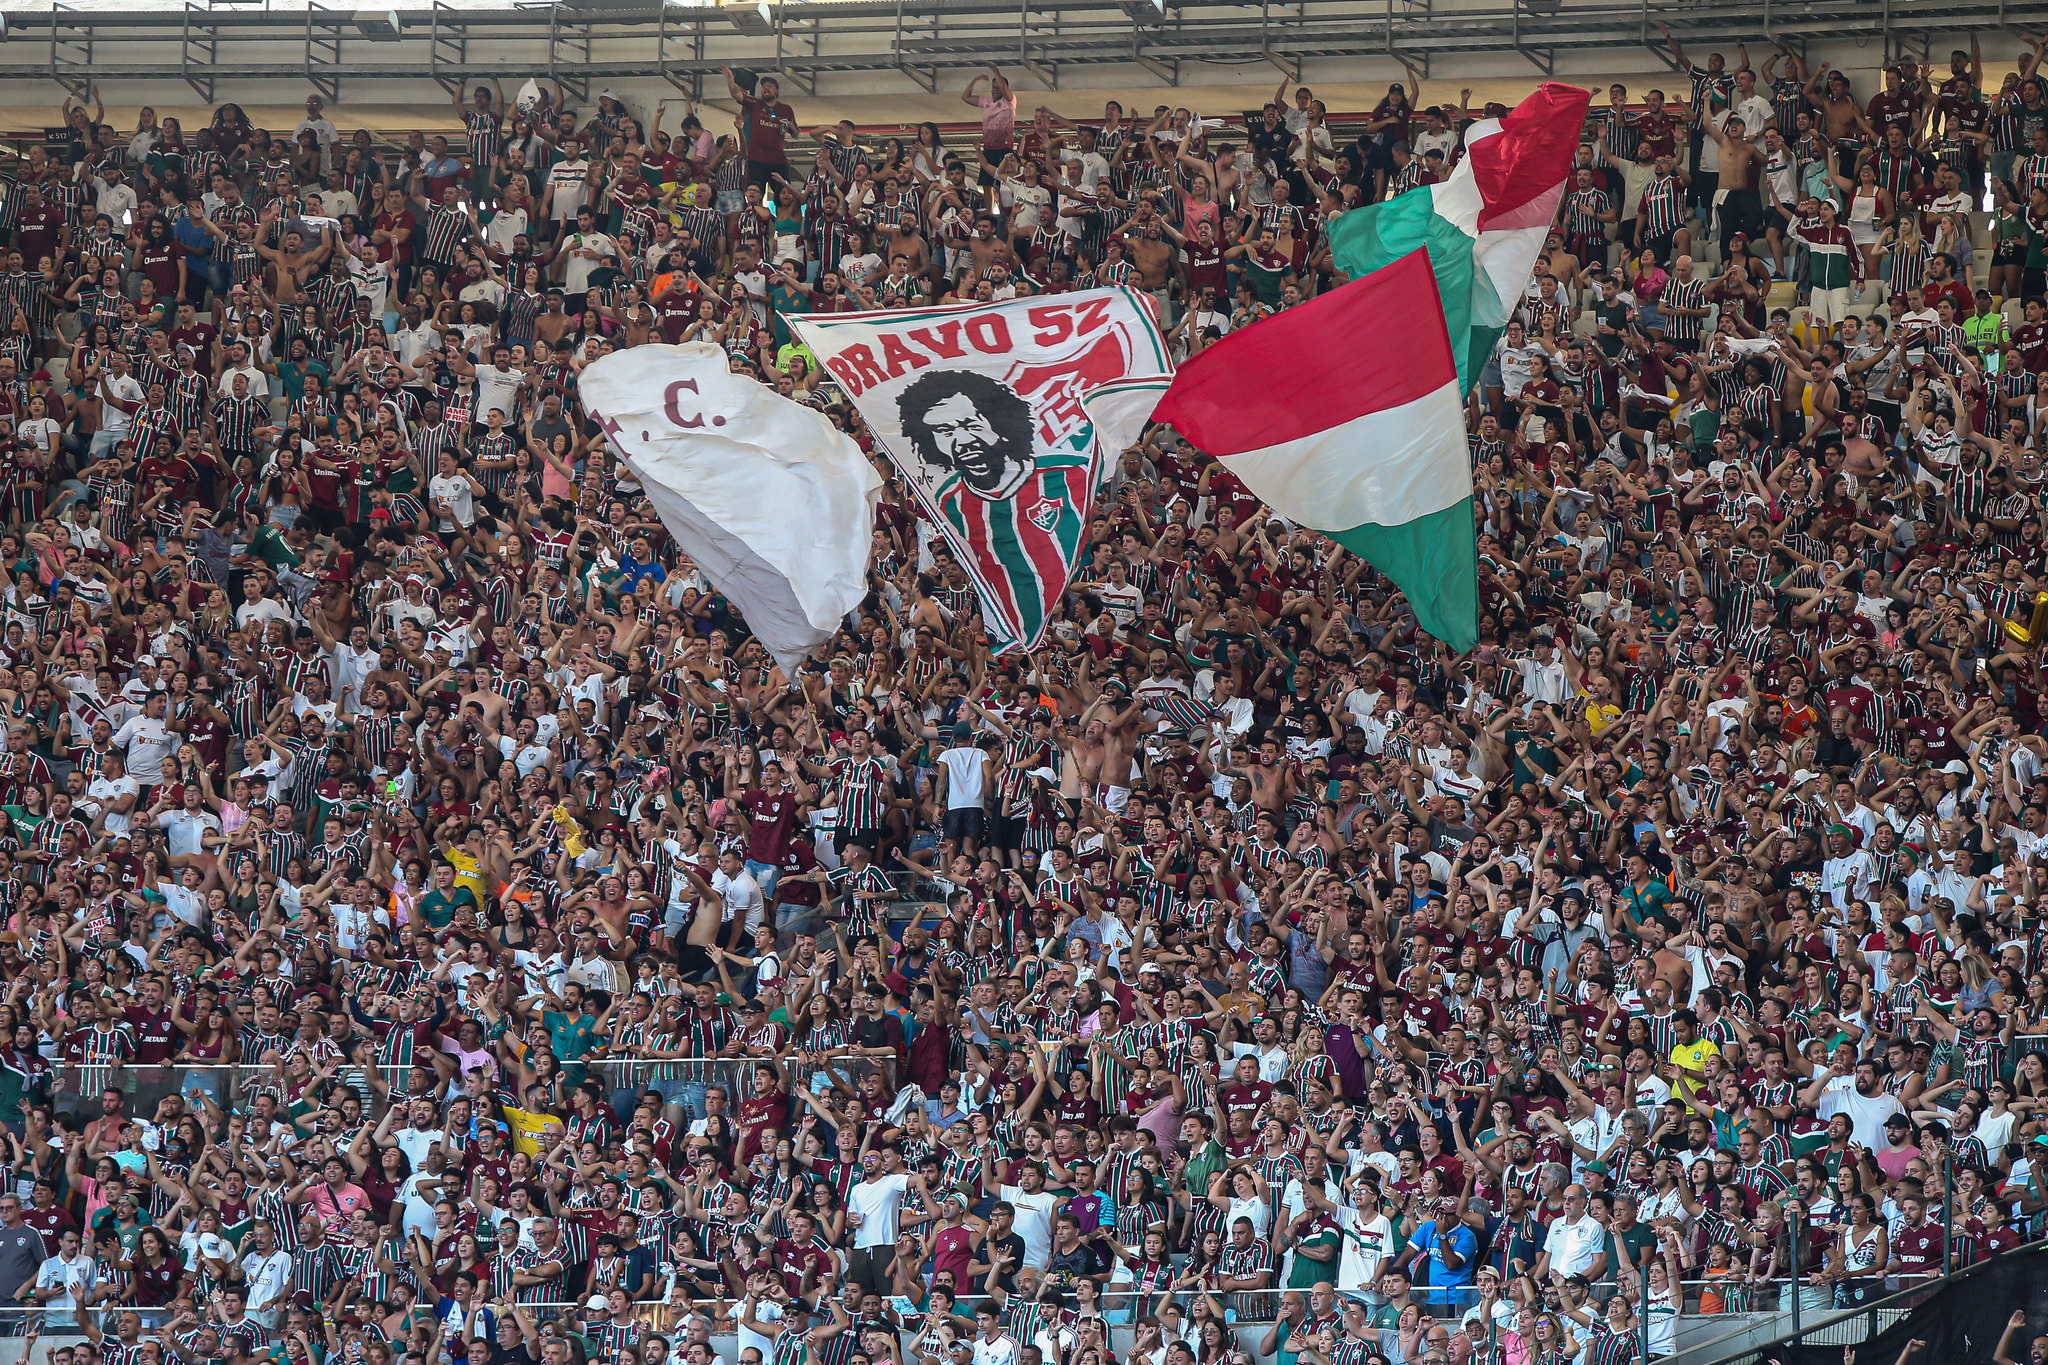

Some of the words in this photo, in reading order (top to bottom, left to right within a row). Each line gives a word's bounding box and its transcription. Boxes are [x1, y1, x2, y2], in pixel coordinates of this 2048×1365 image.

[1200, 258, 1219, 266] BETANO
[825, 313, 1014, 398] BRAVO
[664, 378, 726, 428] C.
